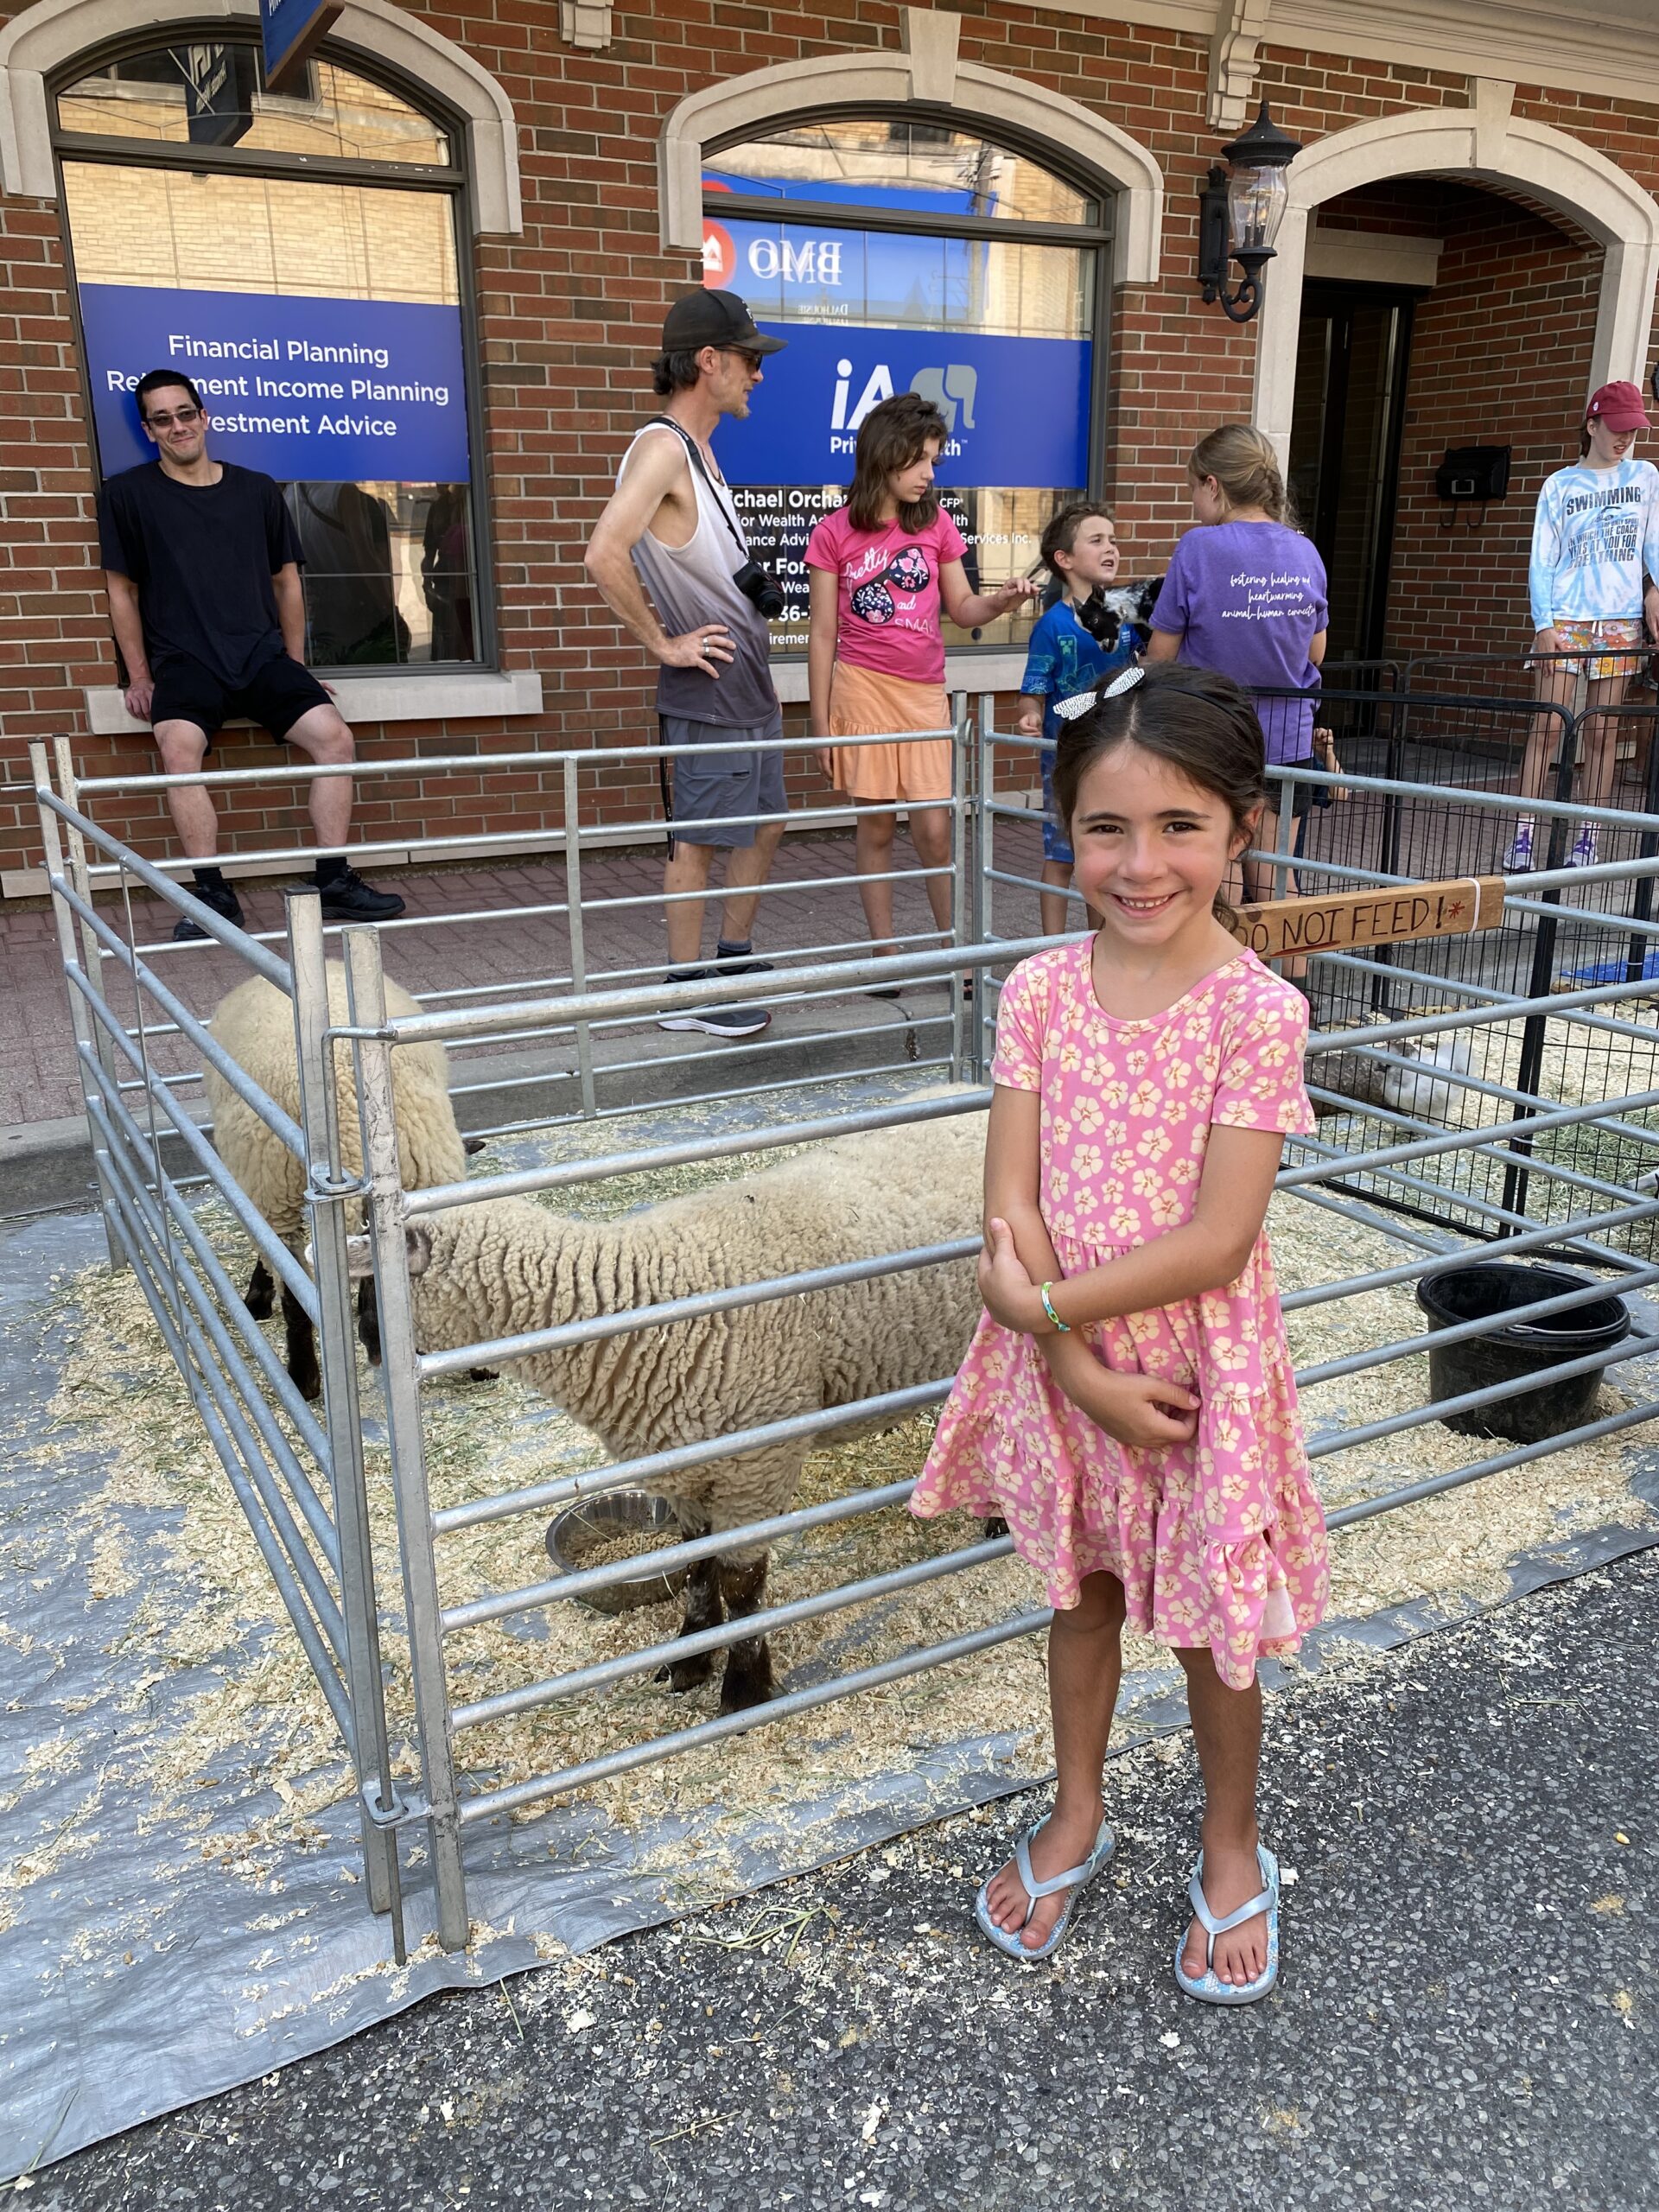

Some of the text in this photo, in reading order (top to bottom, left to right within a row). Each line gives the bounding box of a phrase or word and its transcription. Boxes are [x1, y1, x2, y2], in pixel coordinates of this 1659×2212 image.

[168, 334, 389, 369] Financial Planning
[106, 370, 449, 406] Rement Income Planning
[830, 358, 895, 430] iA
[207, 412, 397, 436] estment Advice
[728, 489, 783, 508] chael
[1566, 486, 1642, 516] SWIMMING
[758, 513, 805, 527] Wealth
[960, 532, 1009, 545] Services
[1011, 532, 1032, 544] Inc.
[1601, 525, 1616, 538] THE
[1616, 524, 1638, 535] COACH
[1604, 535, 1621, 550] YOU
[1622, 534, 1637, 548] FOR
[1230, 571, 1268, 587] fostering
[1270, 571, 1300, 587] healing
[1248, 588, 1304, 604] heartwarming
[1222, 605, 1285, 620] animal-human
[1282, 907, 1344, 950] NOT
